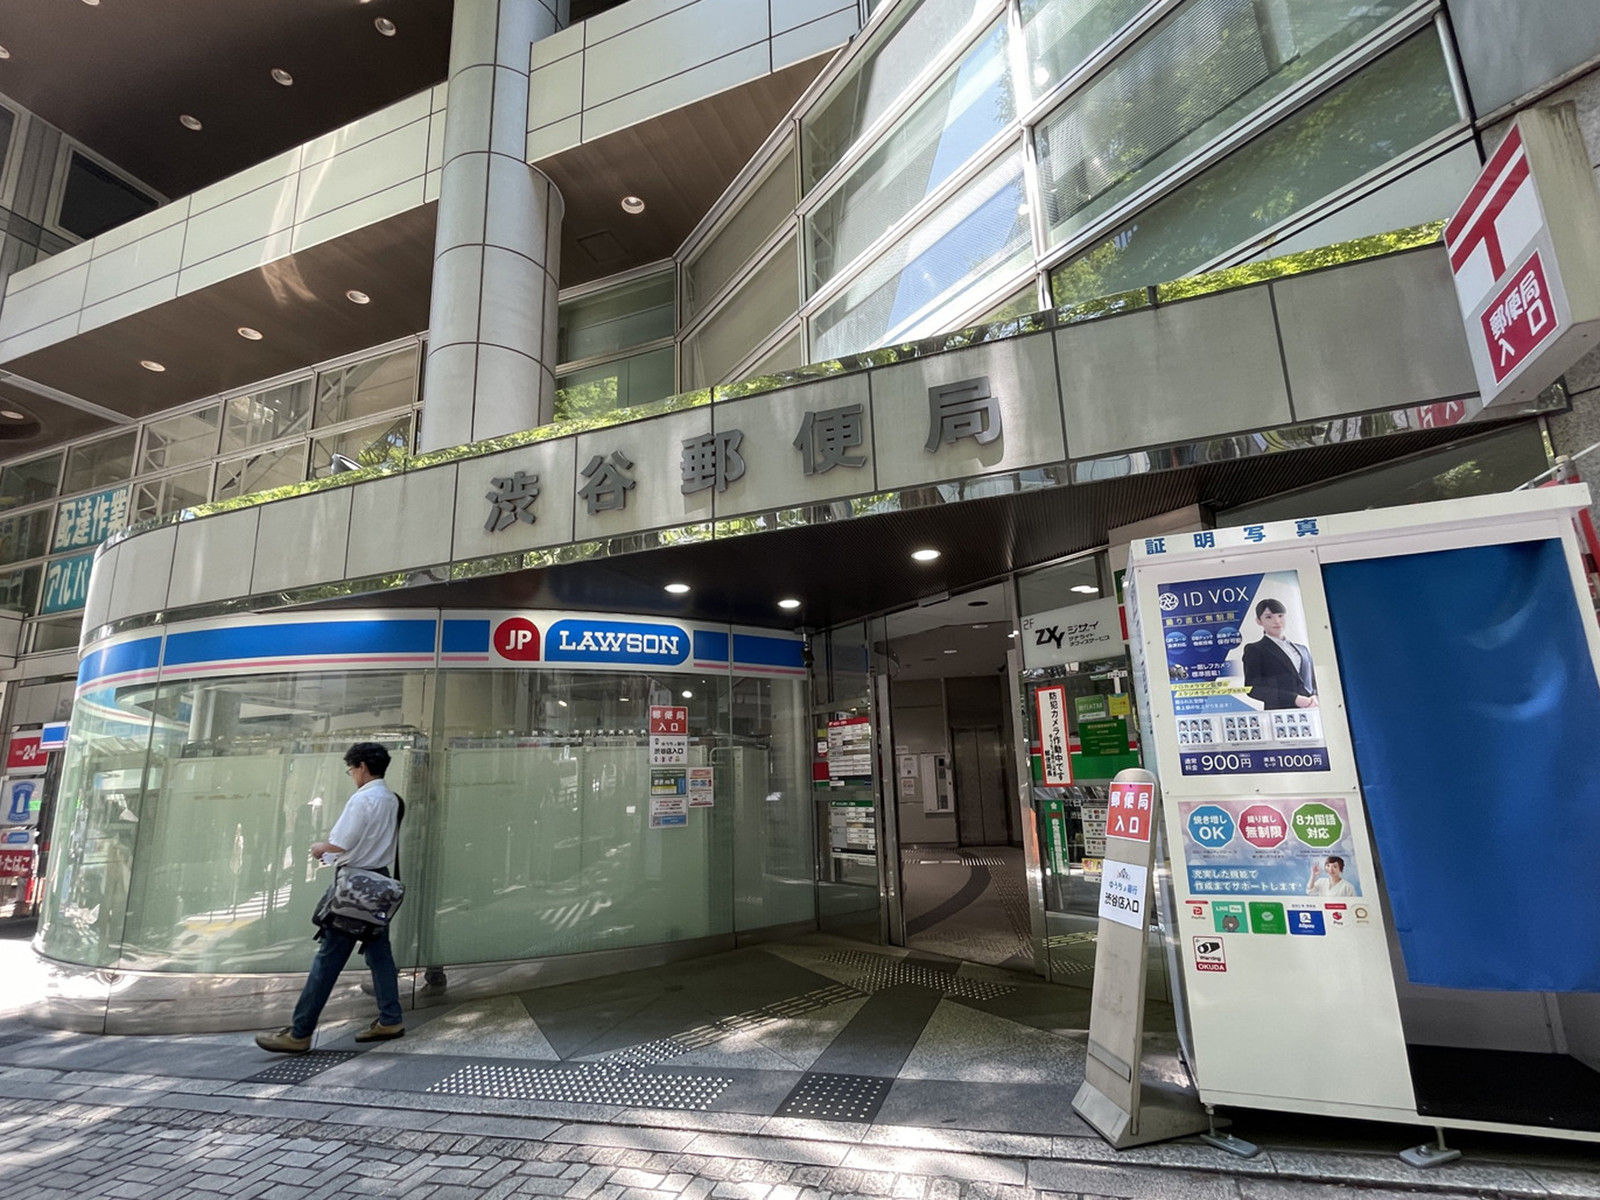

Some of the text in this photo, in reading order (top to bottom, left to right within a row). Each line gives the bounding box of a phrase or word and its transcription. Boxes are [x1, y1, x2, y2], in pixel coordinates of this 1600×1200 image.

[1489, 269, 1540, 341] 郵便局
[483, 375, 1002, 532] 渋谷郵便局
[54, 488, 128, 549] 配達作業
[1145, 518, 1319, 555] 証明写真
[1183, 586, 1249, 608] ID VOX
[1023, 618, 1034, 630] 2F
[505, 630, 532, 650] JP
[559, 630, 680, 655] LAWSON
[1035, 625, 1065, 649] ZXY
[1190, 662, 1231, 671] 一眼レフカメラ
[653, 710, 685, 720] 郵便局
[659, 722, 679, 732] 入口
[1049, 692, 1064, 781] 防犯カメラ作動中です
[22, 744, 37, 760] 24
[1201, 754, 1252, 771] 900円
[1277, 754, 1323, 768] 1000円
[1110, 791, 1149, 811] 郵便局
[1114, 815, 1140, 834] 入口
[1193, 815, 1228, 825] 焼き増し
[1199, 827, 1226, 841] OK
[1245, 826, 1283, 839] 無制限
[1306, 827, 1330, 839] 対応
[1191, 869, 1258, 879] 充実した機能で
[1108, 880, 1138, 896] ゆうちょ銀行
[1104, 891, 1140, 914] 渋谷店入口
[1199, 955, 1222, 963] Warning
[1198, 963, 1226, 972] OKUDA
